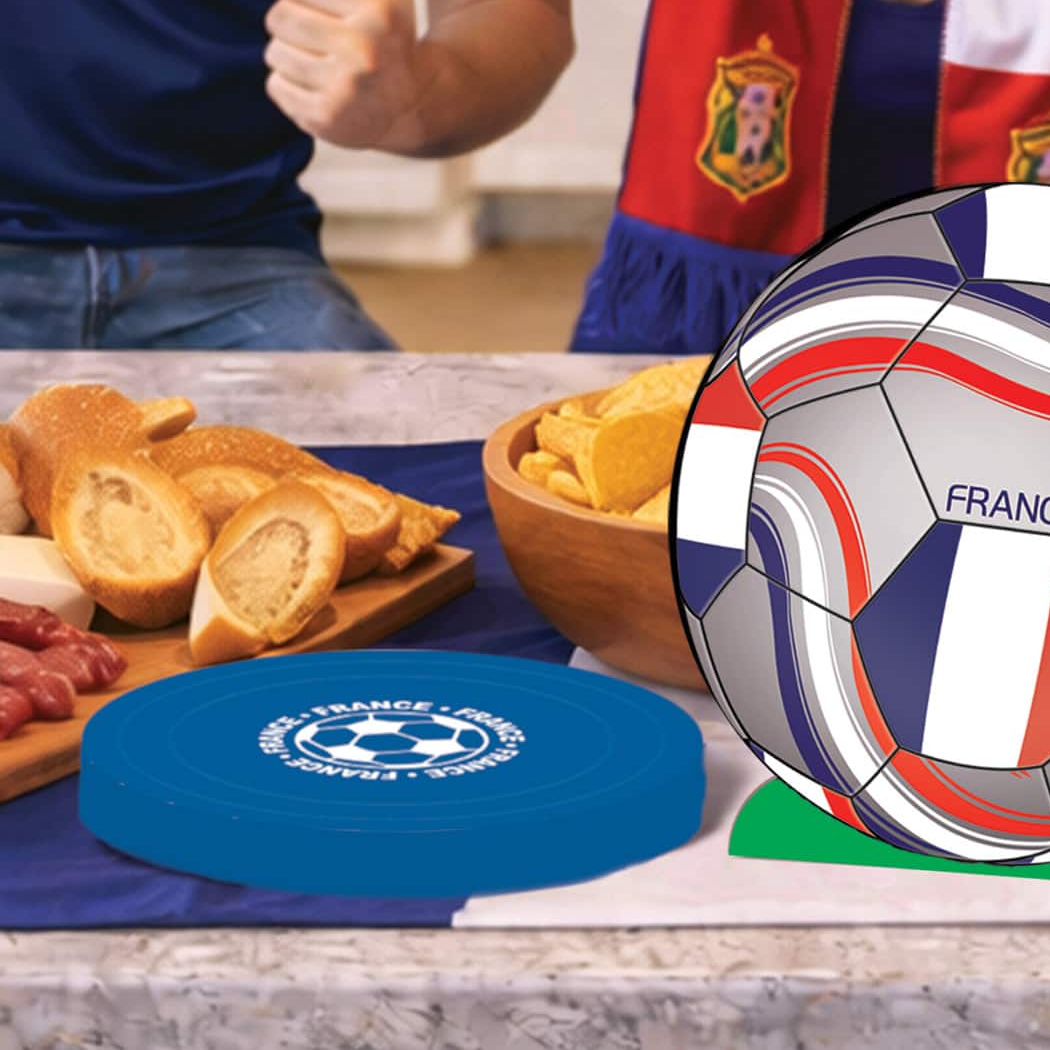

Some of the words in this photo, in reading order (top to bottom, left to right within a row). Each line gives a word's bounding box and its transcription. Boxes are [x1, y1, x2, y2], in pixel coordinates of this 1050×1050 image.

[310, 700, 434, 717] FRANCE
[258, 715, 304, 754] FRANCE
[452, 707, 526, 742] FRANCE
[284, 757, 397, 781] FRANCE
